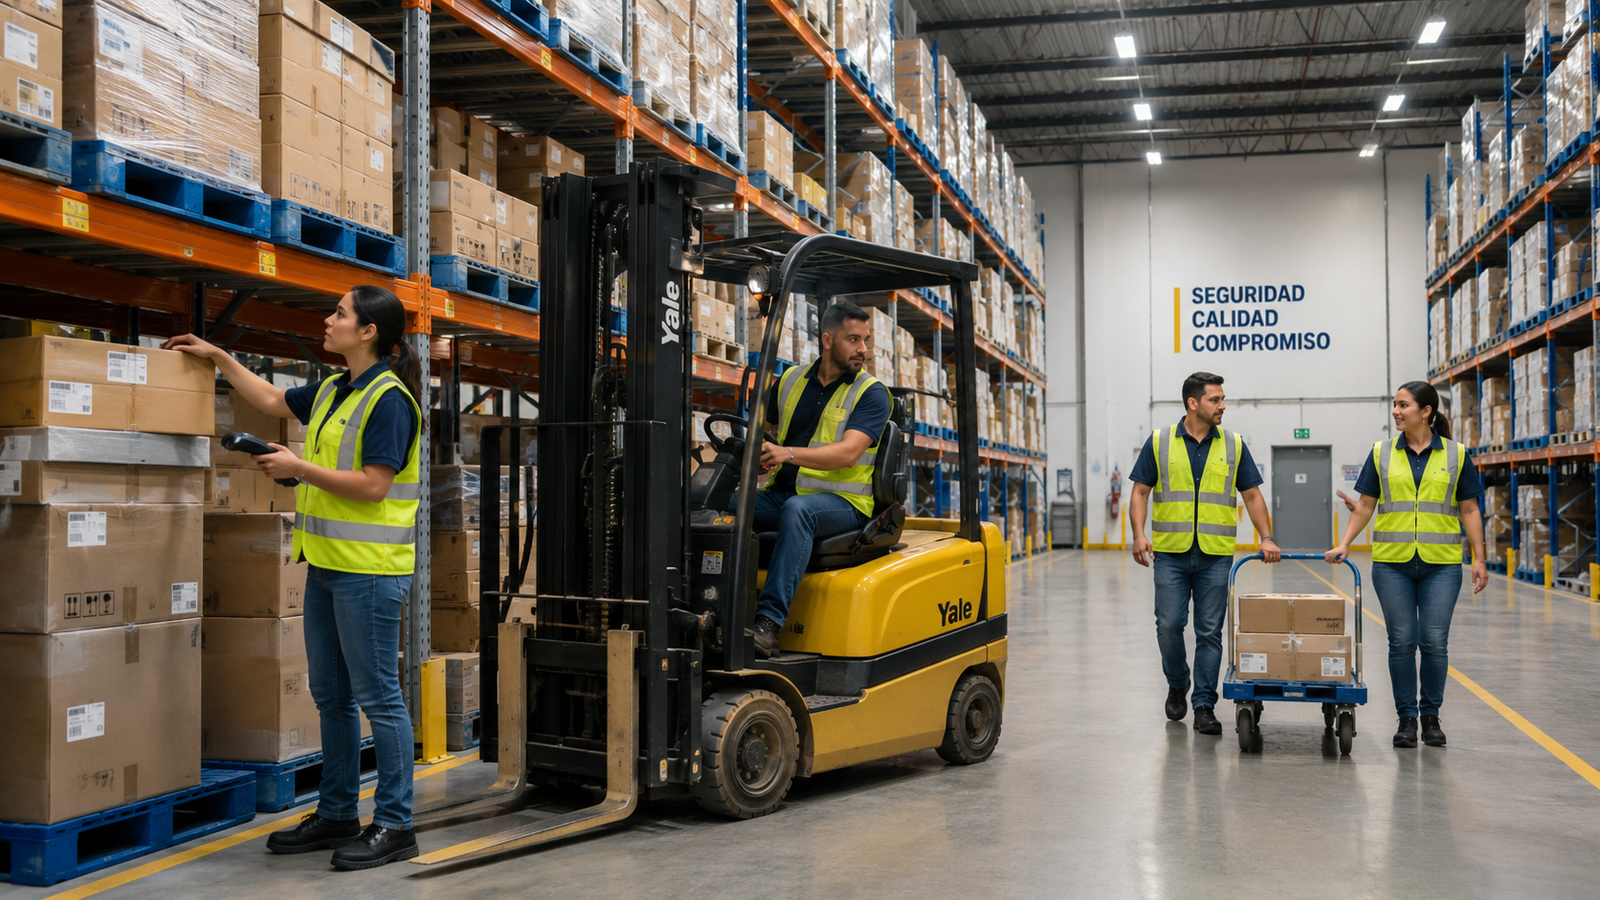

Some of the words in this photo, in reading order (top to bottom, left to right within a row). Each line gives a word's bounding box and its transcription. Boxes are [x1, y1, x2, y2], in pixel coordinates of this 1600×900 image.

[1191, 284, 1306, 304] SEGURIDAD
[661, 280, 680, 345] Yale
[1191, 309, 1279, 329] CALIDAD
[1191, 332, 1331, 353] COMPROMISO
[937, 597, 972, 628] Yale
